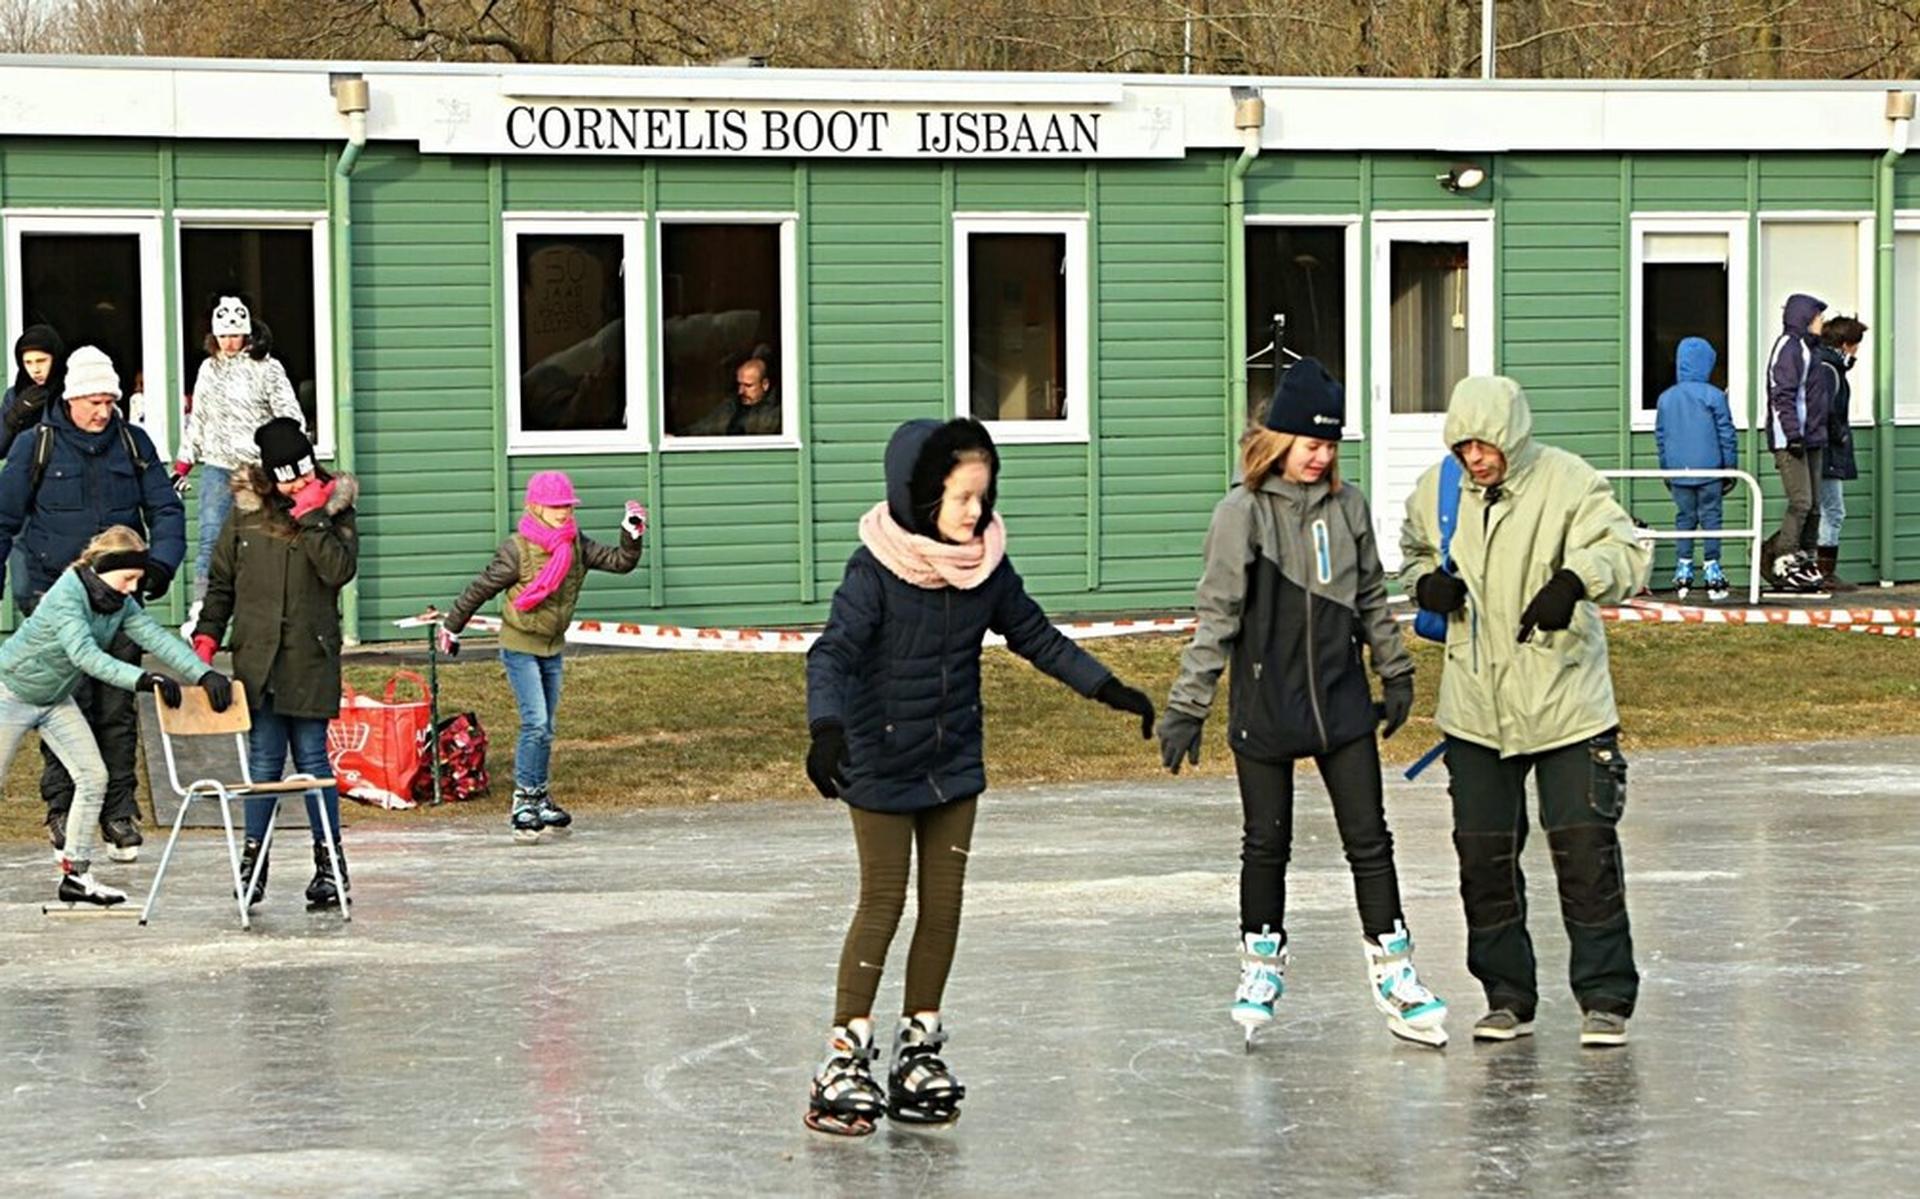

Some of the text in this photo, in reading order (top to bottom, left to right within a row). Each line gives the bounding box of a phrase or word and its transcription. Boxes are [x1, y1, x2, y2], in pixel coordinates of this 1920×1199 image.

[506, 106, 1101, 153] CORNELIS BOOT IJSBAAN
